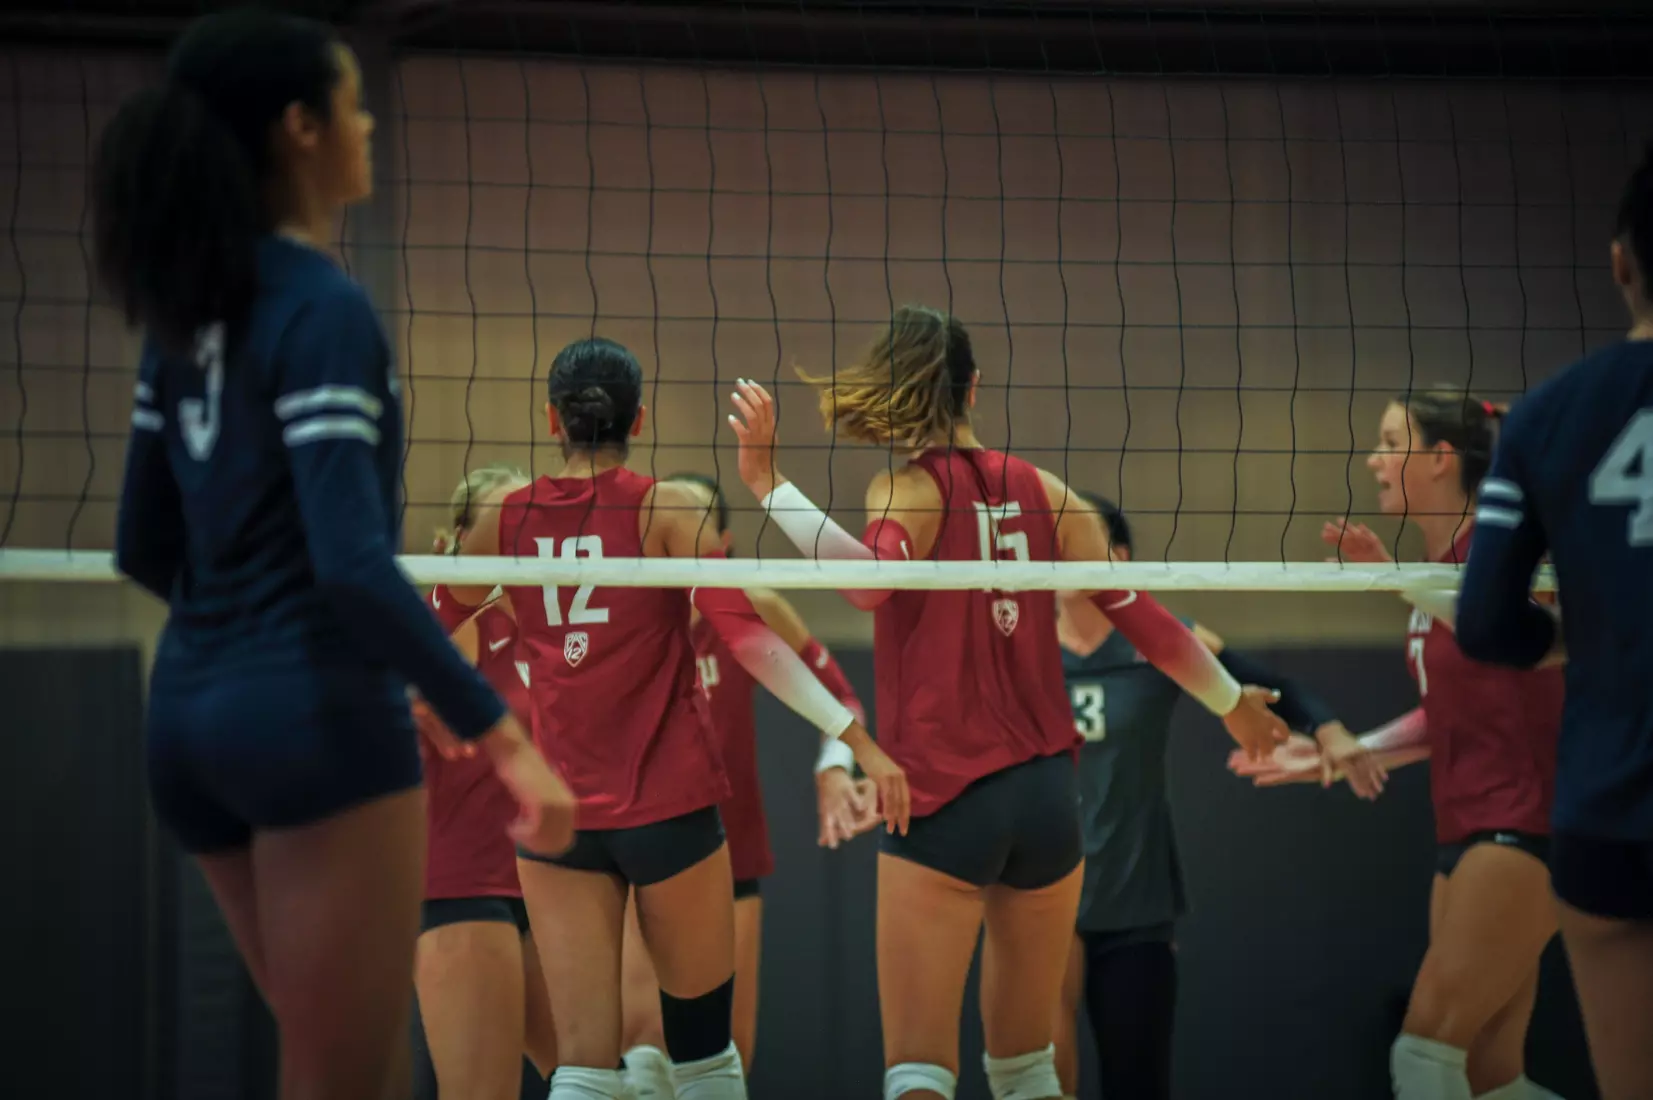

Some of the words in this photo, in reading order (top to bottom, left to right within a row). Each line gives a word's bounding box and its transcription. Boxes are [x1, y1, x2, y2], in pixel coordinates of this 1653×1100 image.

[1589, 408, 1653, 547] 4
[533, 535, 609, 626] 12
[972, 500, 1030, 593] 15
[1071, 684, 1106, 741] 3
